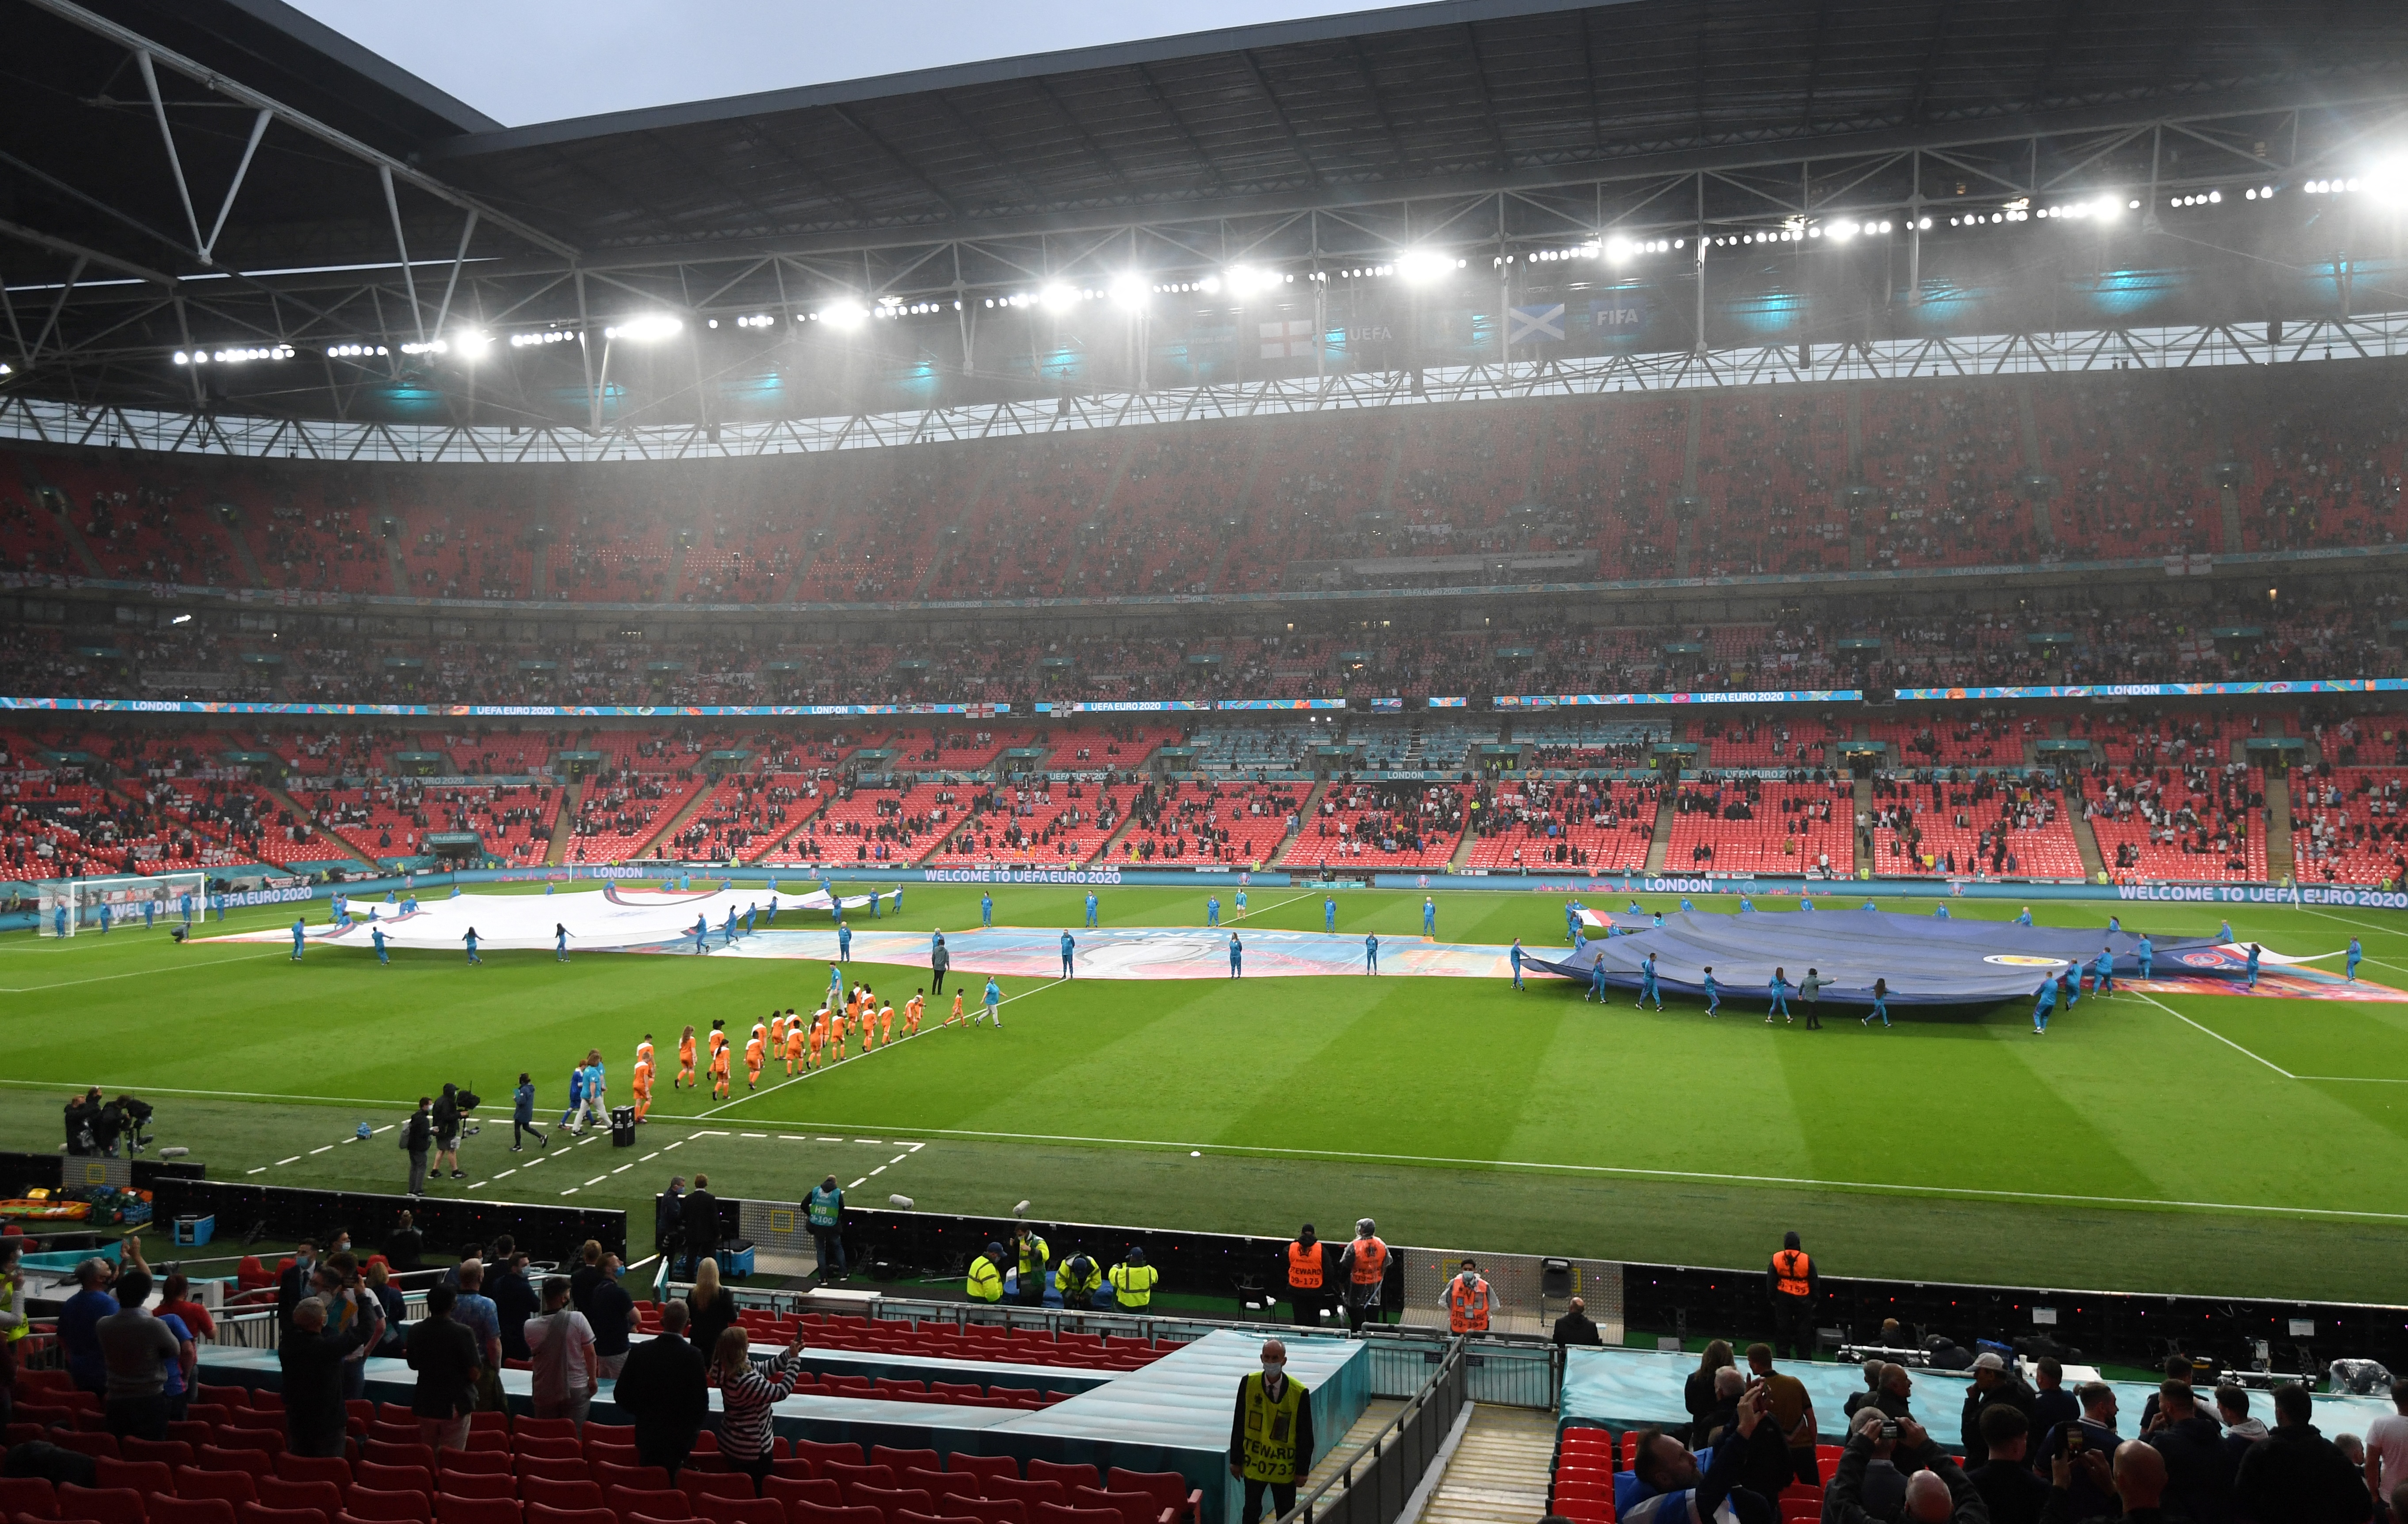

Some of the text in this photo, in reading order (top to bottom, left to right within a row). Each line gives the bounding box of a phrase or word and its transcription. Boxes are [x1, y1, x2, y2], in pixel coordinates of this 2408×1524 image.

[1598, 309, 1639, 325] FIFA
[1350, 327, 1391, 340] UEFA
[2297, 550, 2341, 559] LONDON
[2107, 685, 2160, 695] LONDON
[1758, 692, 1784, 701] 2020
[133, 701, 181, 711] LONDON
[1751, 770, 1778, 778] EURO
[593, 867, 643, 878] LONDON
[925, 870, 1121, 884] WELCOME TO UEFA EURO 2020
[1645, 878, 1712, 892] LONDON
[191, 896, 208, 910] TO
[247, 889, 281, 905] EURO
[282, 886, 313, 901] 2020
[2118, 886, 2408, 908] WELCOME TO UEFA EURO 2020
[1084, 930, 1303, 940] LONDON
[815, 1205, 827, 1215] HB
[1244, 1436, 1295, 1460] TEWARD
[1243, 1454, 1296, 1476] 9-0733
